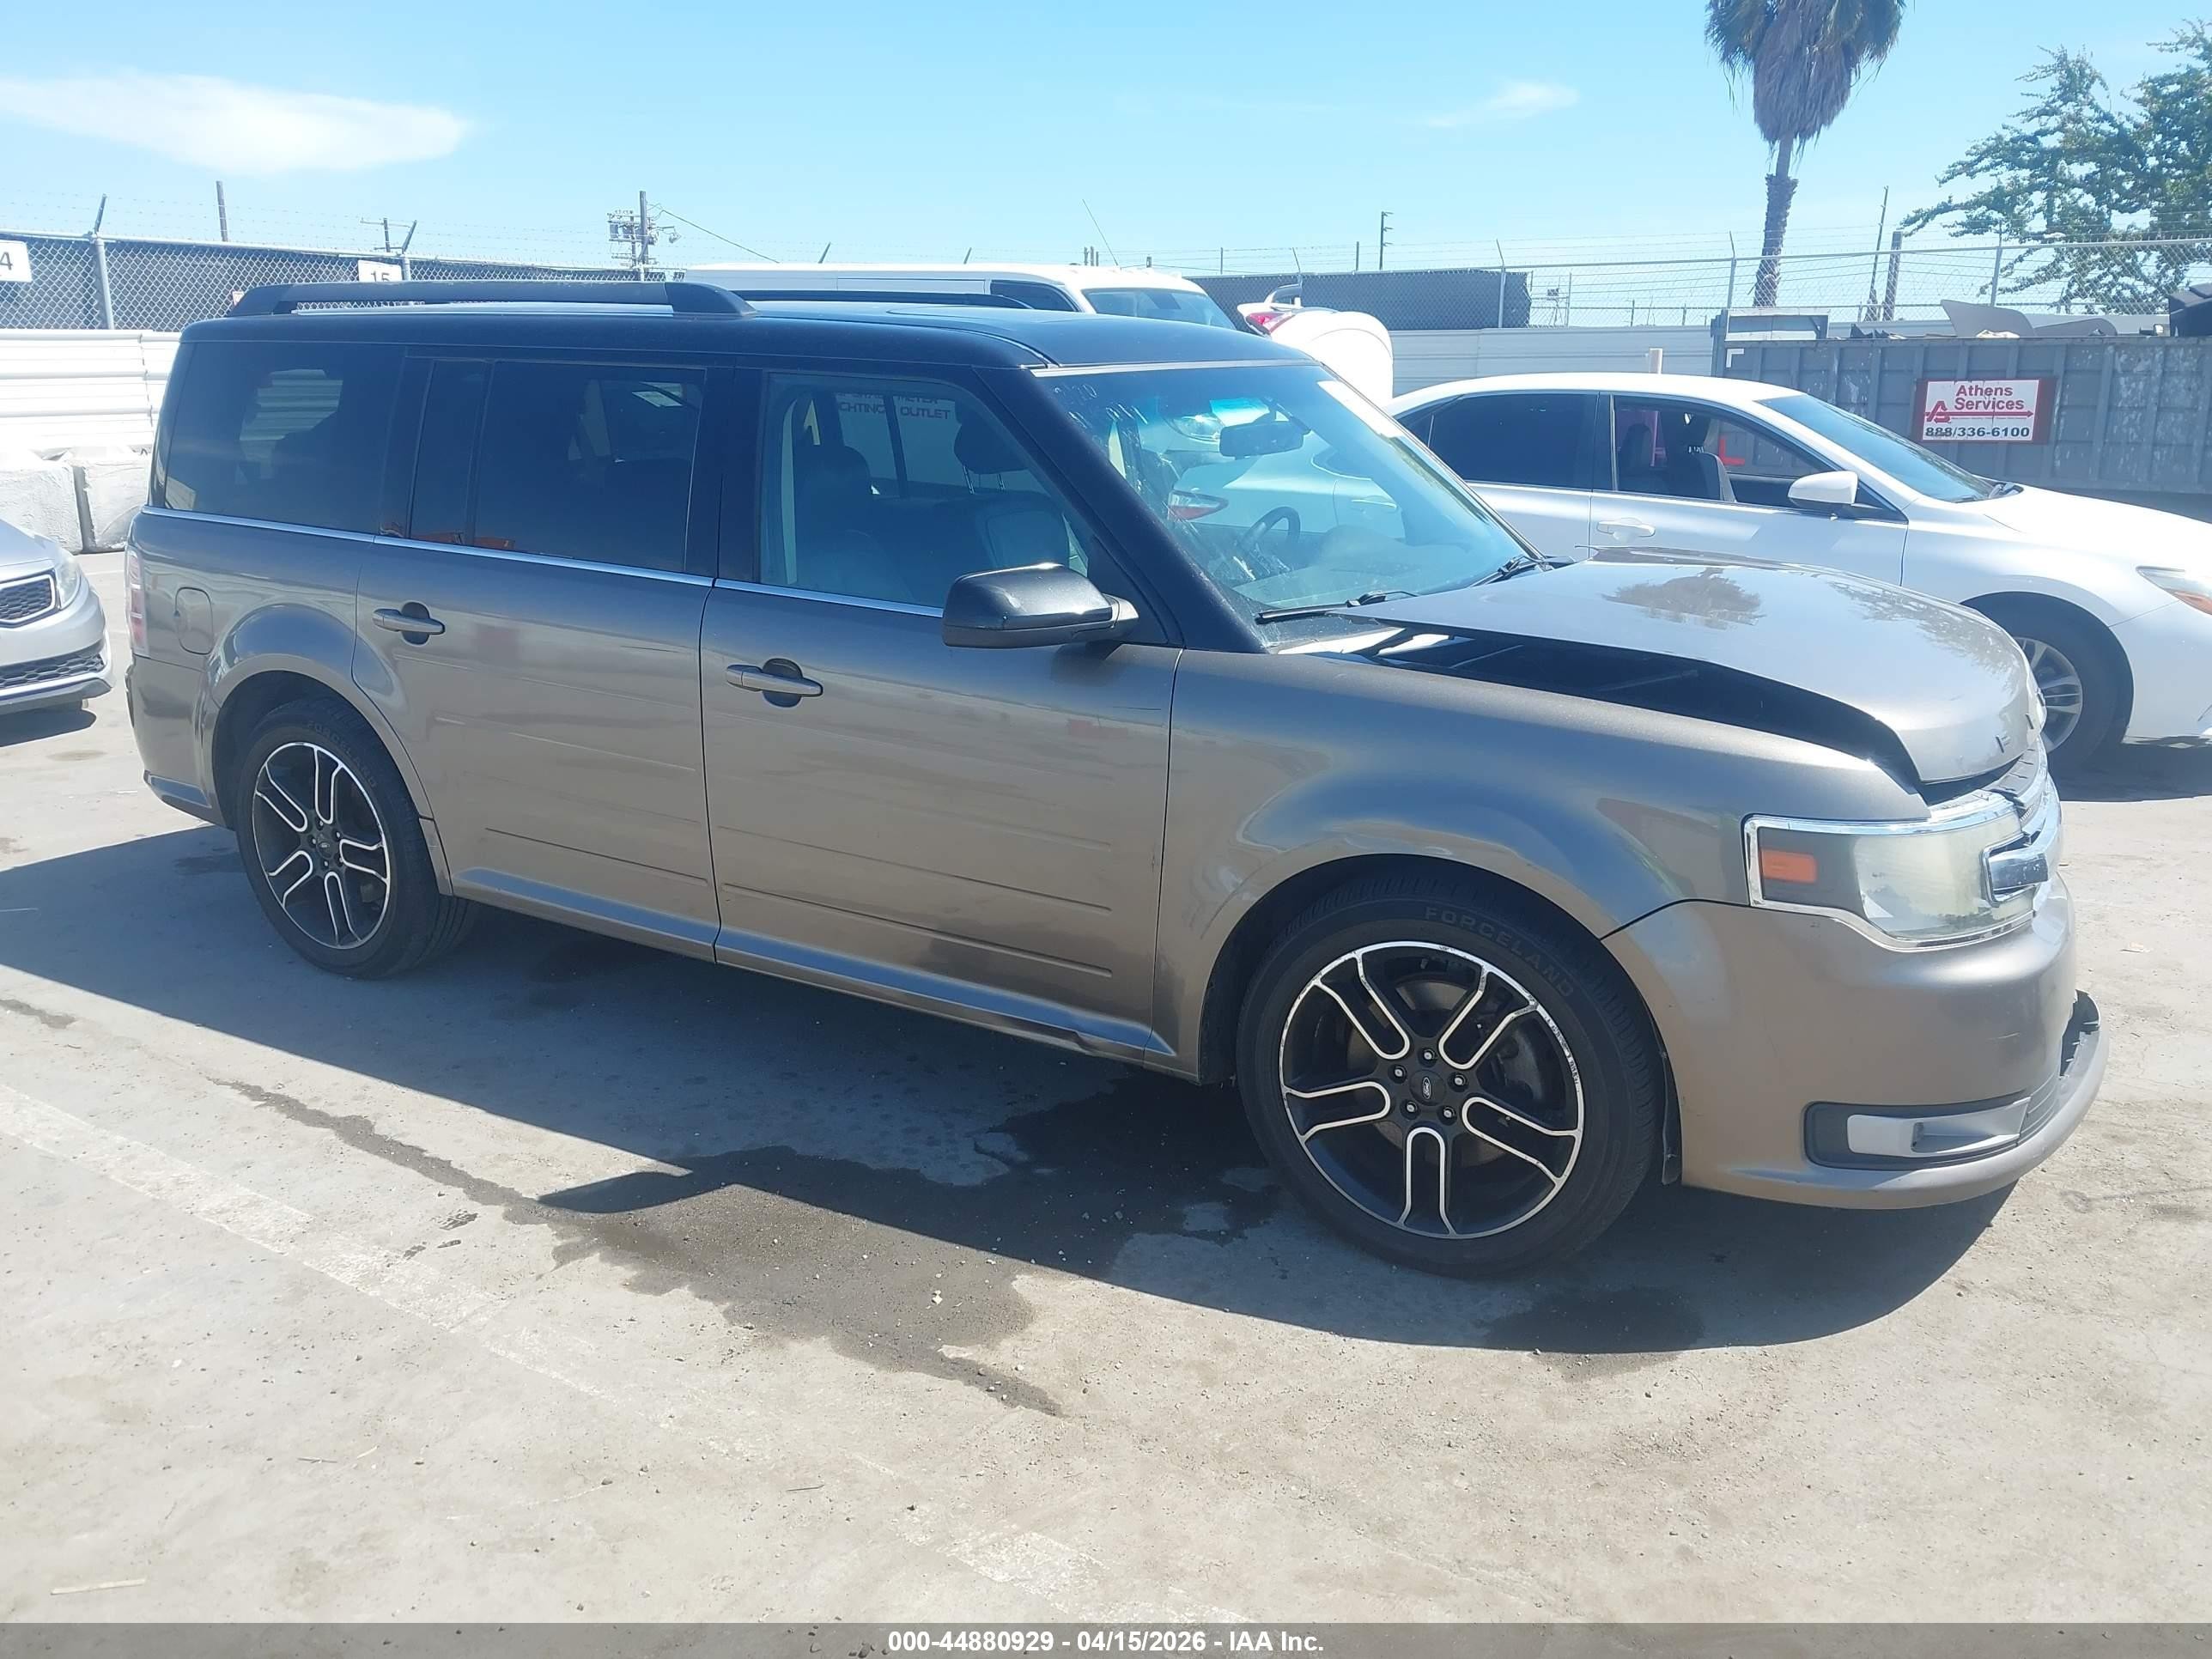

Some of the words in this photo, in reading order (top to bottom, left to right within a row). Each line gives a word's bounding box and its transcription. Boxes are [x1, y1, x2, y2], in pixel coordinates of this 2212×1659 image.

[1955, 385, 2014, 397] Athens
[1954, 398, 2025, 410] Services
[901, 406, 951, 420] OUTLET
[1924, 427, 2030, 437] 888/336-6100
[1425, 906, 1574, 997] FORCELAND
